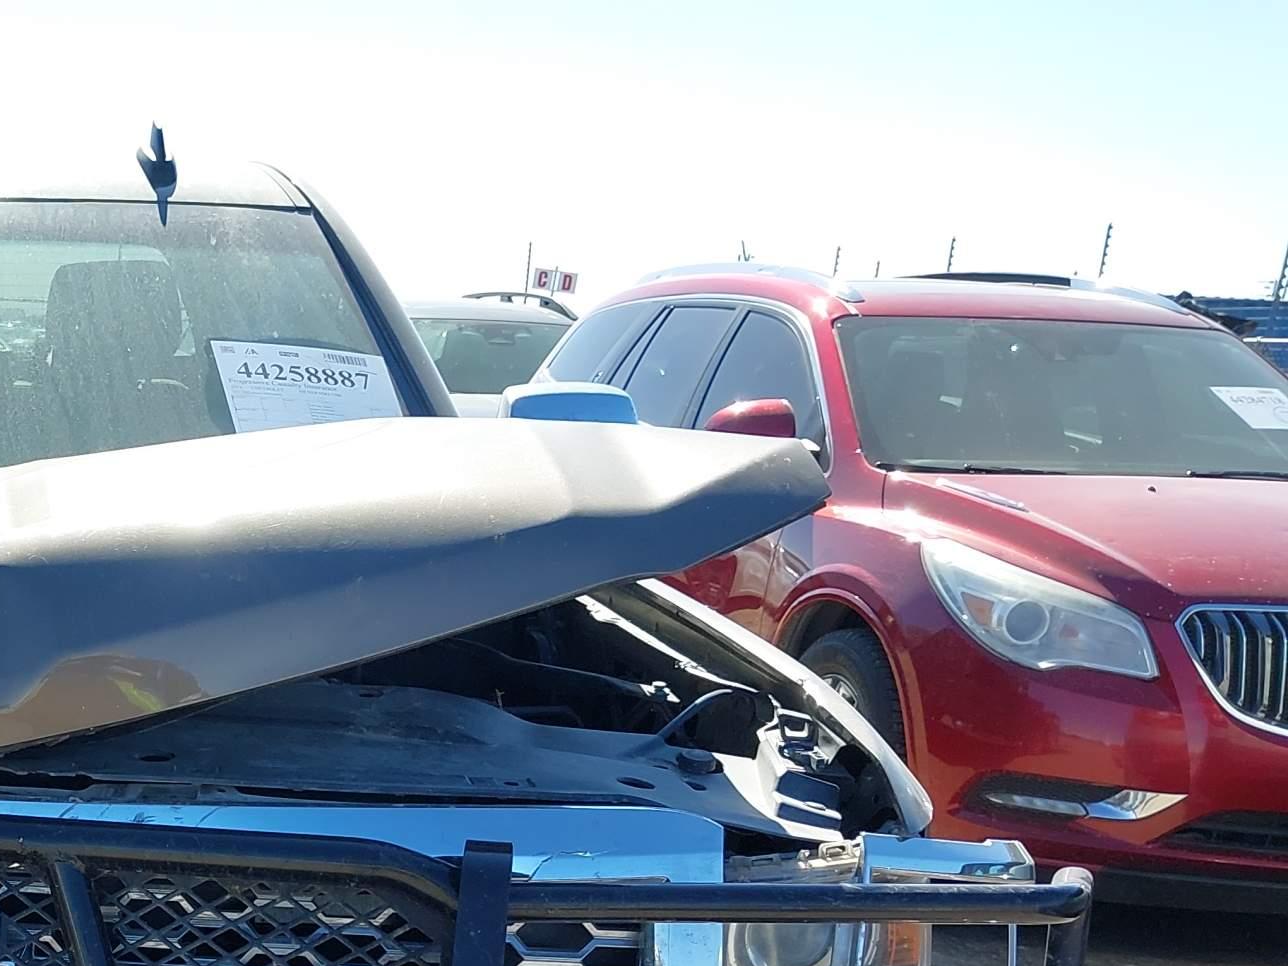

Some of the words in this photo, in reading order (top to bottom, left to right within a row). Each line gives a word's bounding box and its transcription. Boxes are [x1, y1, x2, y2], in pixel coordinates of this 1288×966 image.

[538, 271, 548, 288] C
[562, 274, 572, 291] D
[237, 361, 369, 390] 44258887
